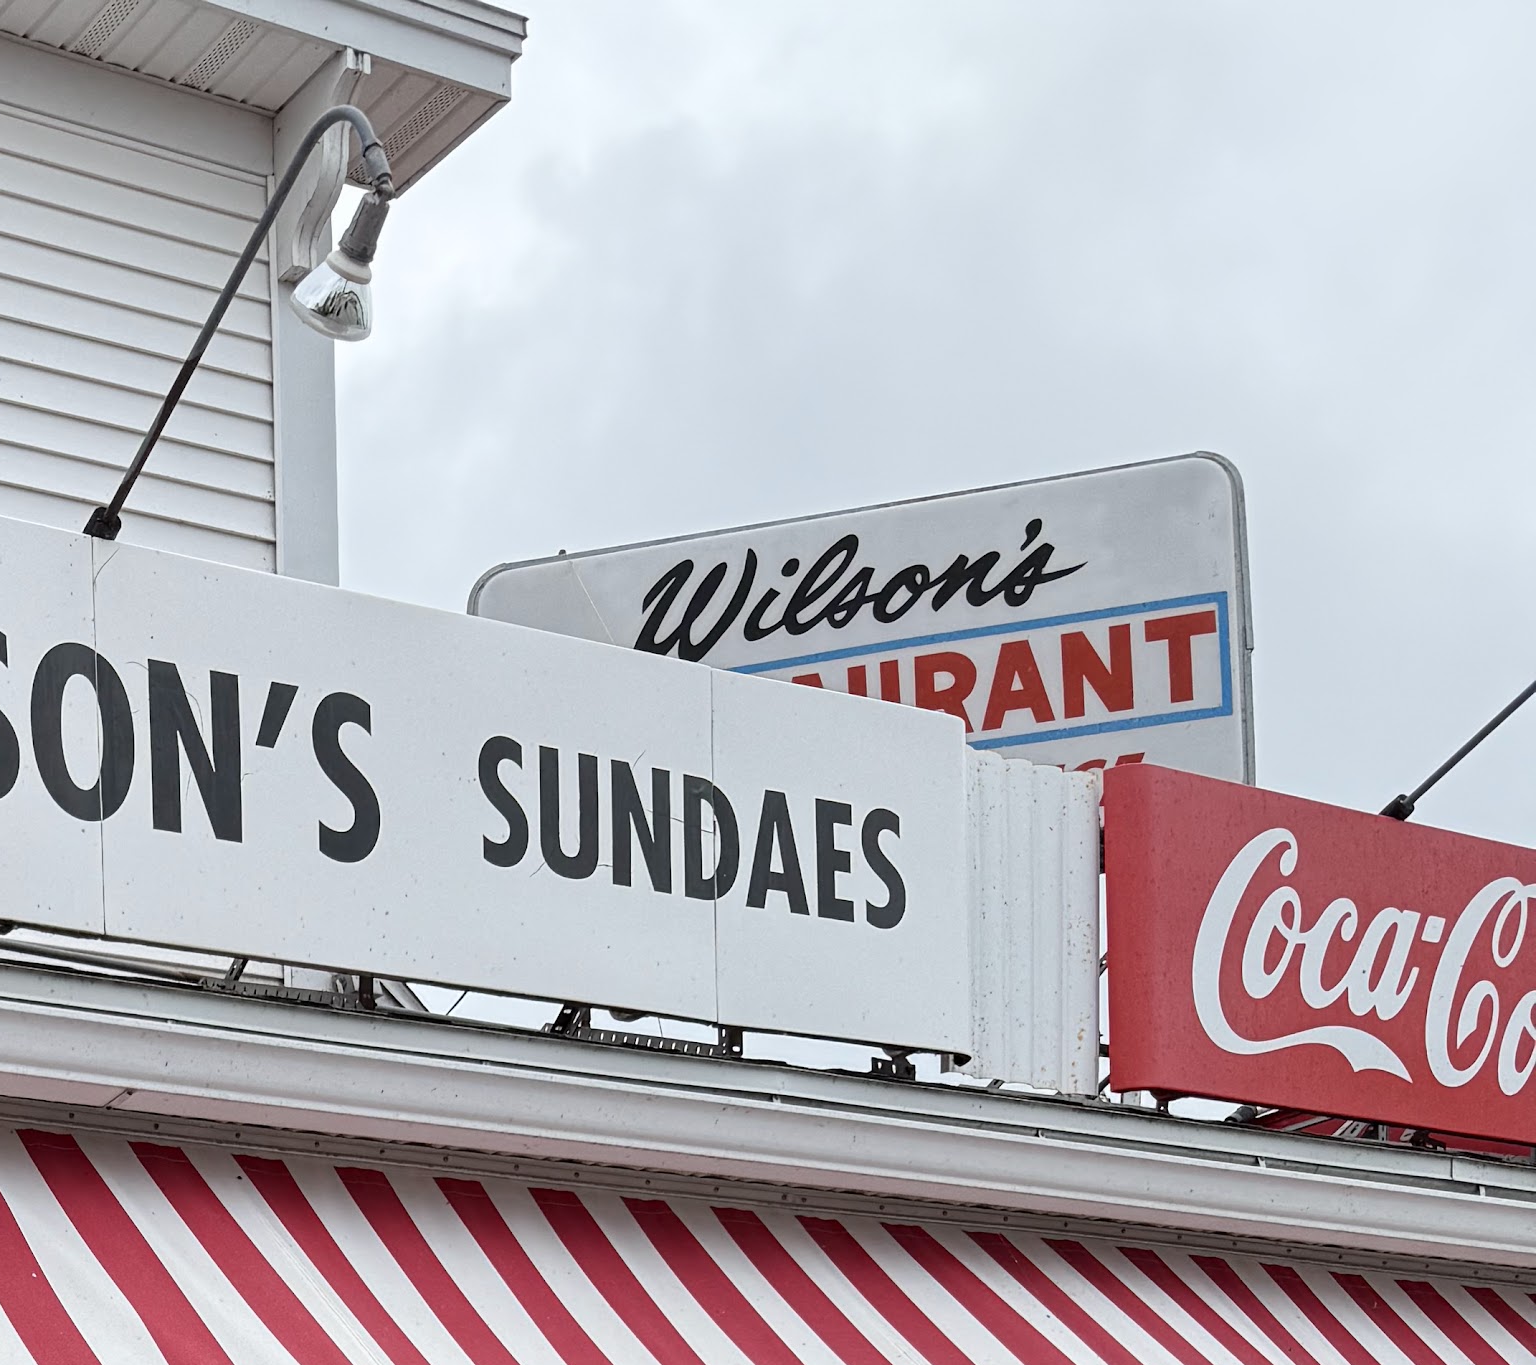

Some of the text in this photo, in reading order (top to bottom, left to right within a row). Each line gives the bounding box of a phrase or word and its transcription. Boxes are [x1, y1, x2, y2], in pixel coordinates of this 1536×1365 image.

[634, 517, 1087, 662] Wilson's
[792, 609, 1217, 736] RANT
[477, 735, 907, 930] SUNDAES
